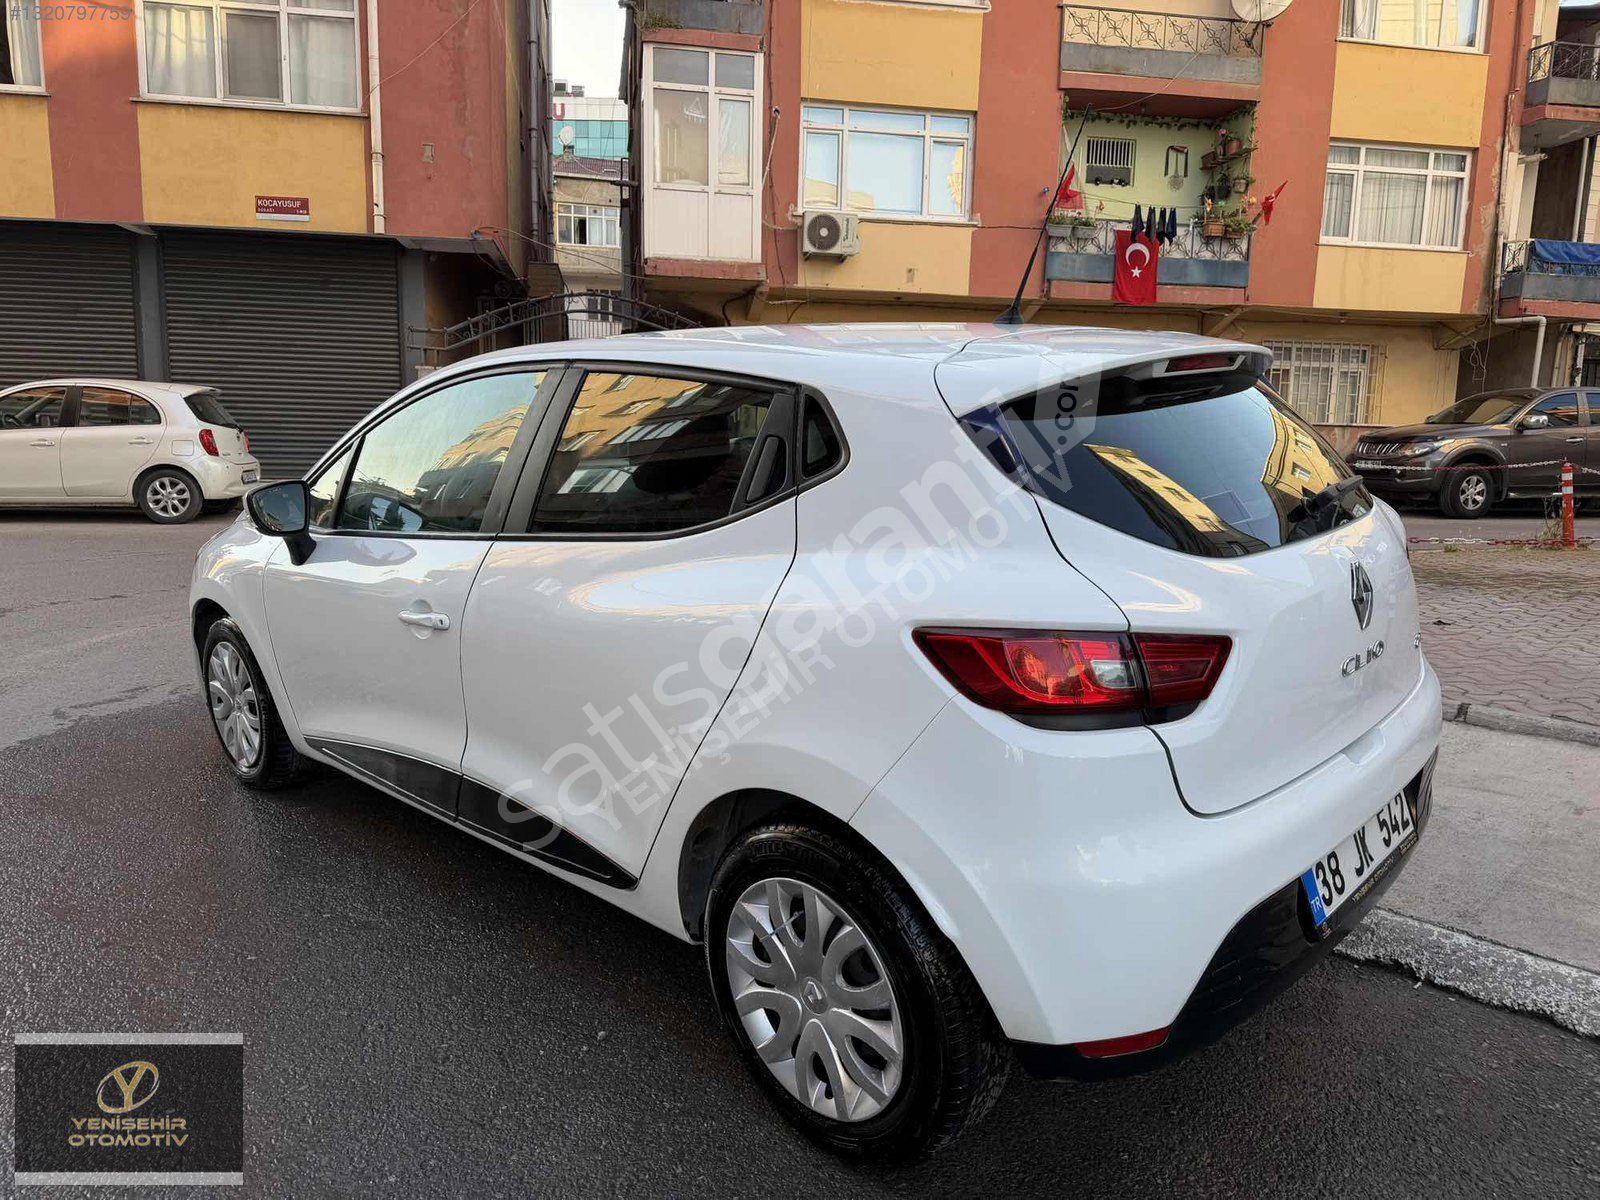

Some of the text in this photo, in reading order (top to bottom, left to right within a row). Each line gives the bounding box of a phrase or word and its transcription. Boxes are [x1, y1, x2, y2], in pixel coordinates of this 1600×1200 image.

[257, 199, 301, 208] KOCAYUSUF
[1341, 640, 1384, 677] CLIO
[1315, 851, 1345, 907] 38
[1353, 825, 1375, 877] JK
[1376, 794, 1410, 847] 542
[1310, 898, 1322, 913] TR
